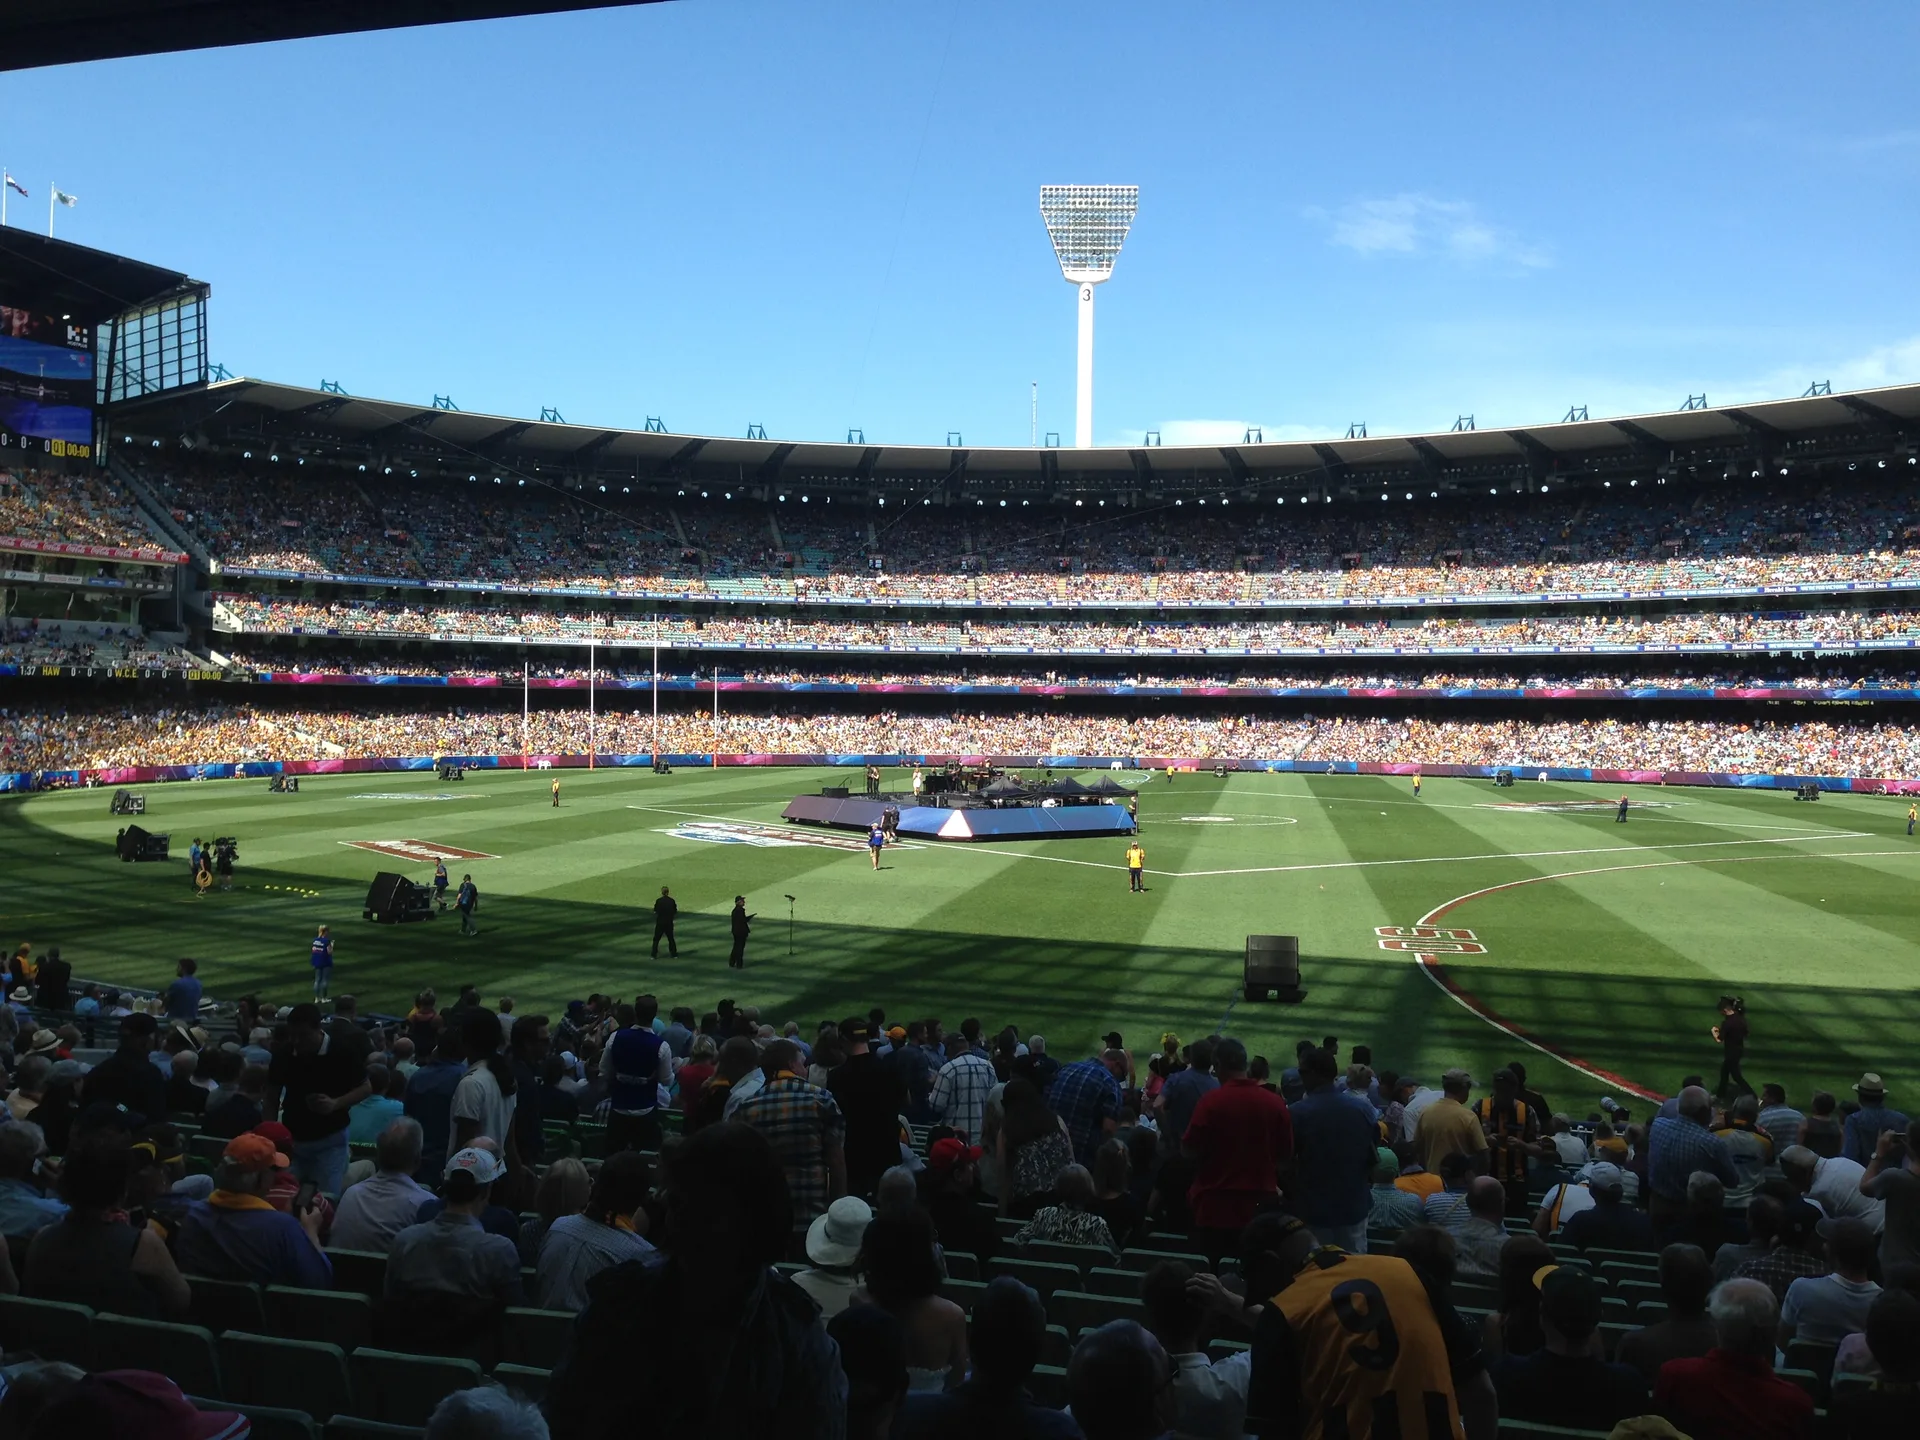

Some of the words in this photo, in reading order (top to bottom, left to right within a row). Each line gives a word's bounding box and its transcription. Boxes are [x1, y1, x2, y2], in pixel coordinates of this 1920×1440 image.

[1082, 289, 1091, 301] 3
[54, 441, 64, 454] Q1
[67, 444, 90, 458] 00:00
[20, 666, 36, 676] 1:37
[42, 667, 60, 677] HAW
[107, 669, 112, 678] 0
[115, 668, 139, 679] W.C.E.
[182, 670, 187, 679] 0
[202, 671, 222, 680] 00:00
[1330, 1278, 1400, 1371] 9
